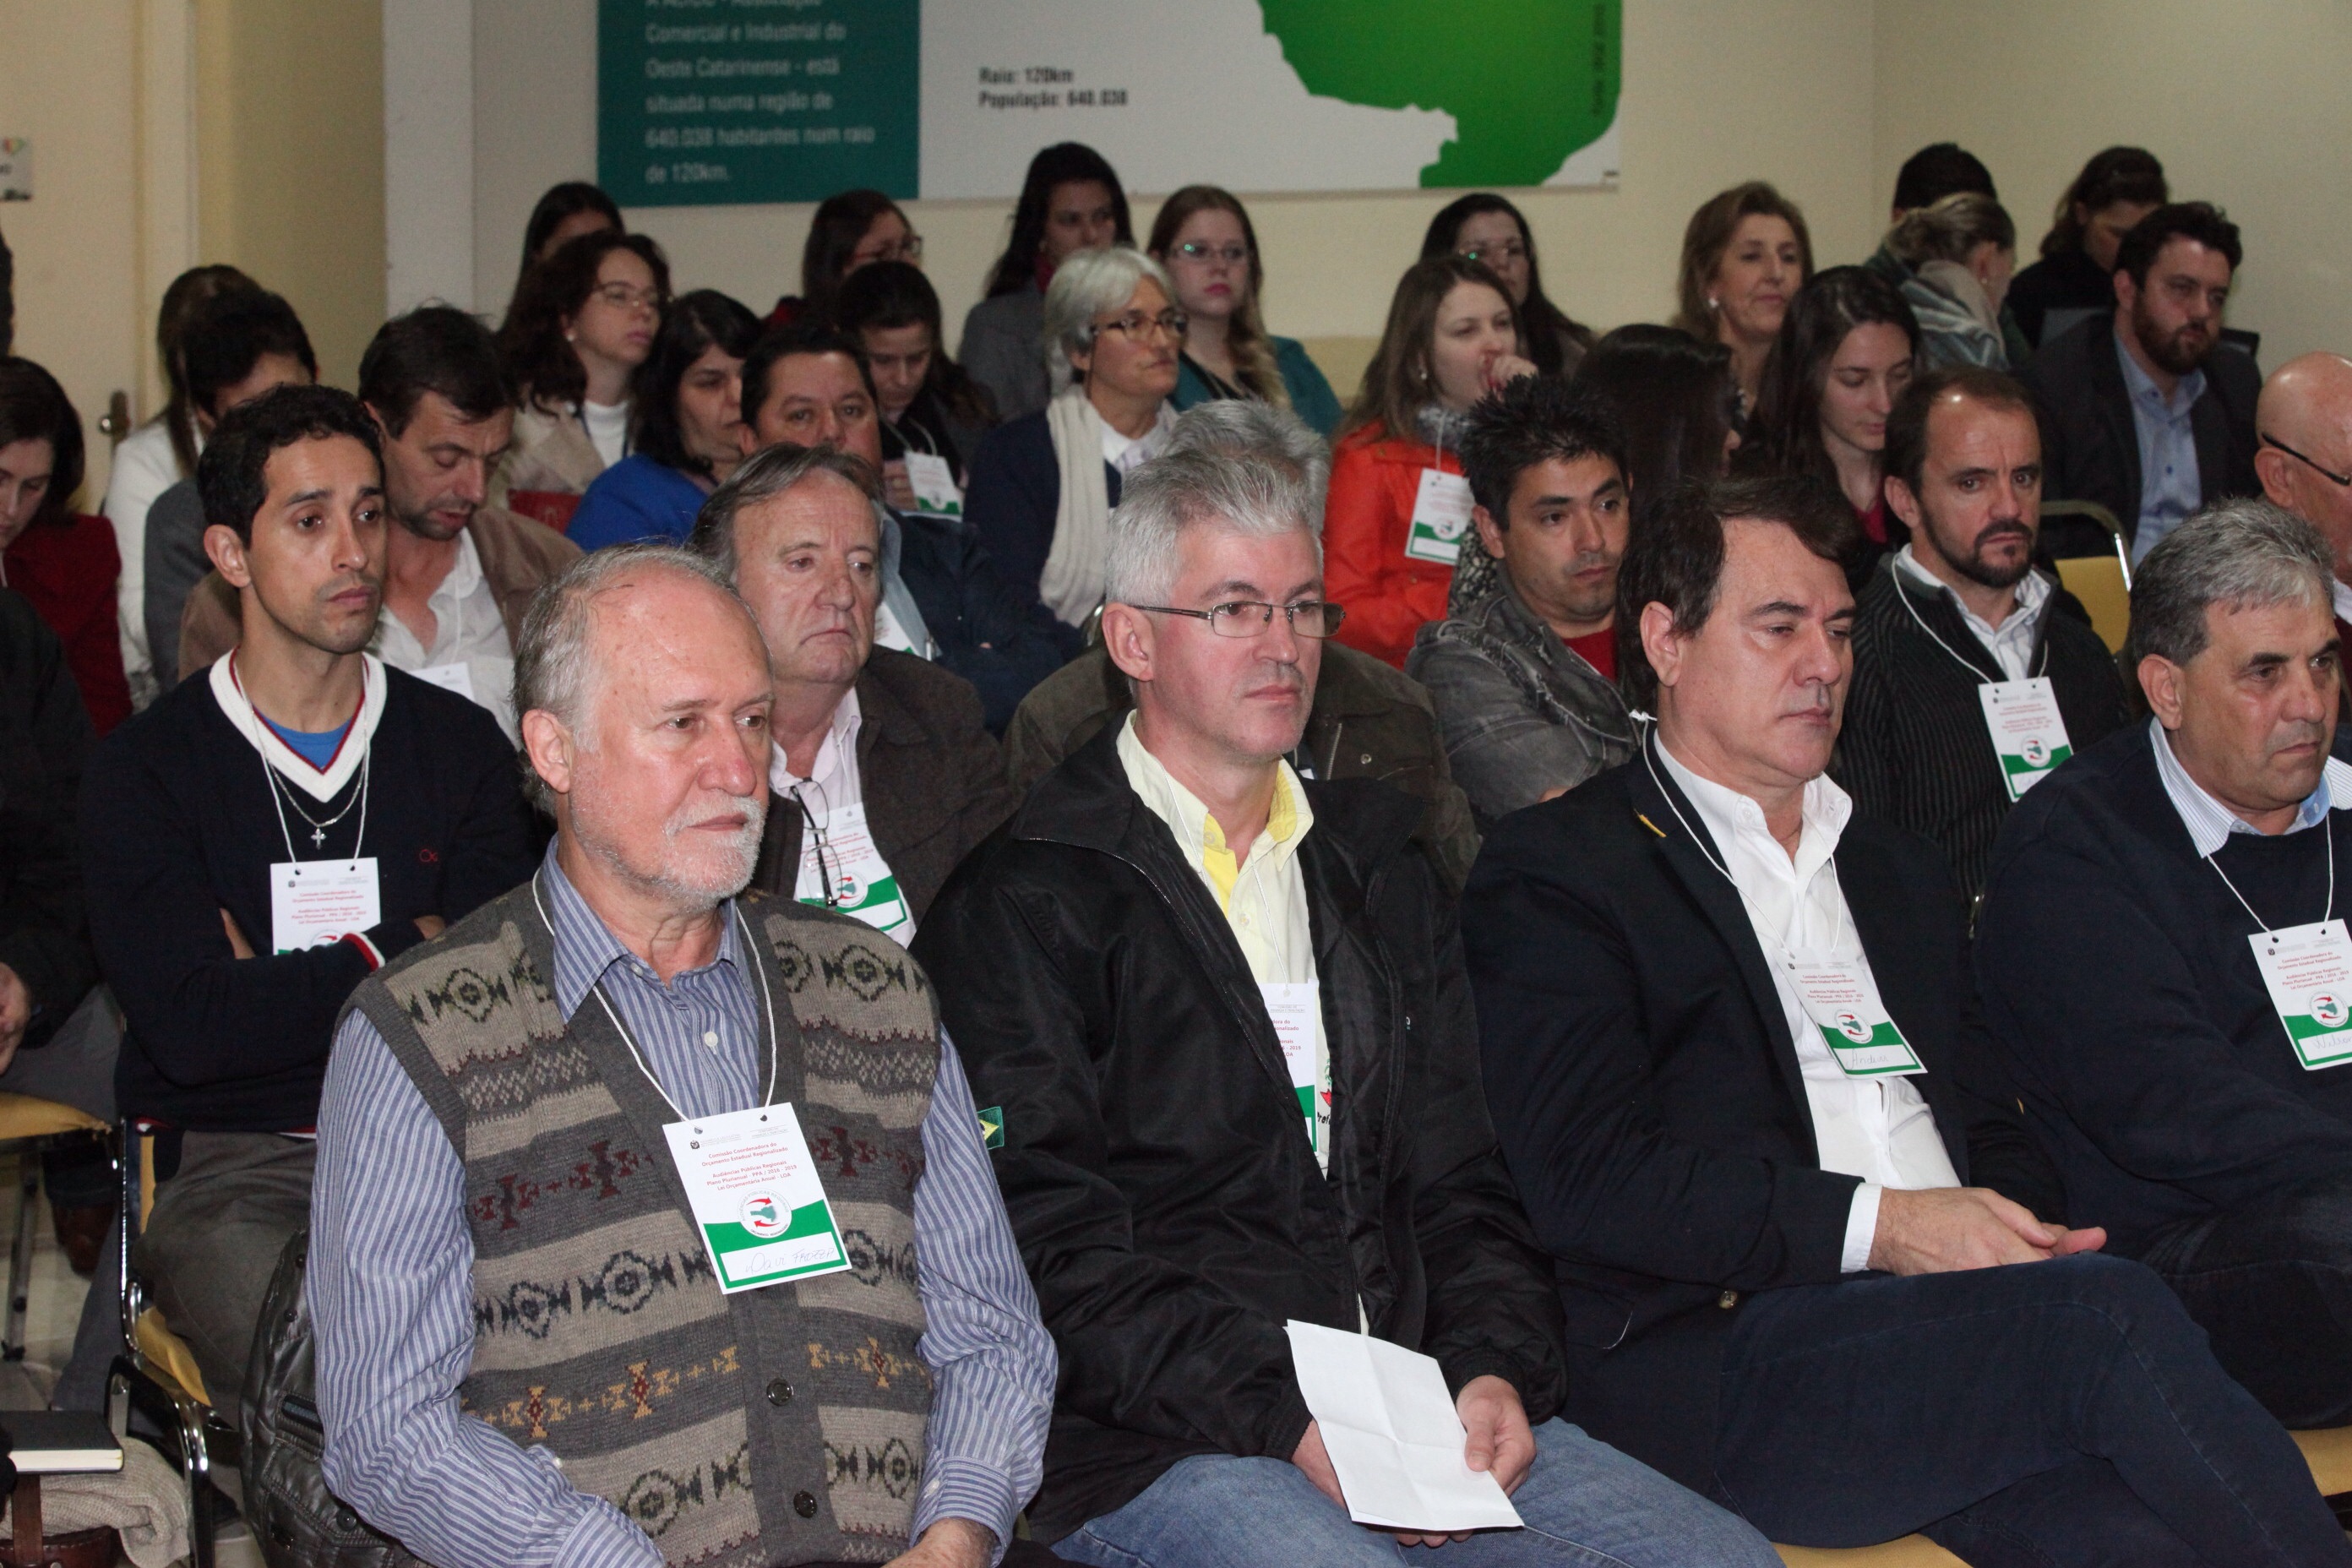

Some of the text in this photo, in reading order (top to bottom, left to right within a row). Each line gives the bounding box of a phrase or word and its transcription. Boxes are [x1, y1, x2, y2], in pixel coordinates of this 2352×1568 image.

[645, 23, 727, 42] Comercial
[730, 25, 741, 41] e
[745, 23, 821, 41] Industrial
[645, 57, 693, 78] Oeste
[695, 57, 791, 77] Catarinense
[806, 57, 841, 75] está
[1026, 67, 1074, 83] 120km
[645, 94, 705, 113] situada
[708, 95, 755, 112] numa
[757, 92, 808, 115] região
[978, 90, 1061, 109] População:
[718, 128, 801, 146] habitantes
[803, 128, 841, 144] num
[843, 127, 876, 144] raio
[645, 165, 667, 183] de
[701, 1146, 788, 1167] Orçamento Estadual Regionalizado
[708, 1150, 733, 1159] Comissão
[733, 1145, 770, 1154] Coordenadora
[712, 1160, 787, 1179] Audiências Públicas Regionais
[722, 1174, 748, 1184] Plurianual
[726, 1179, 760, 1190] Orçamentária
